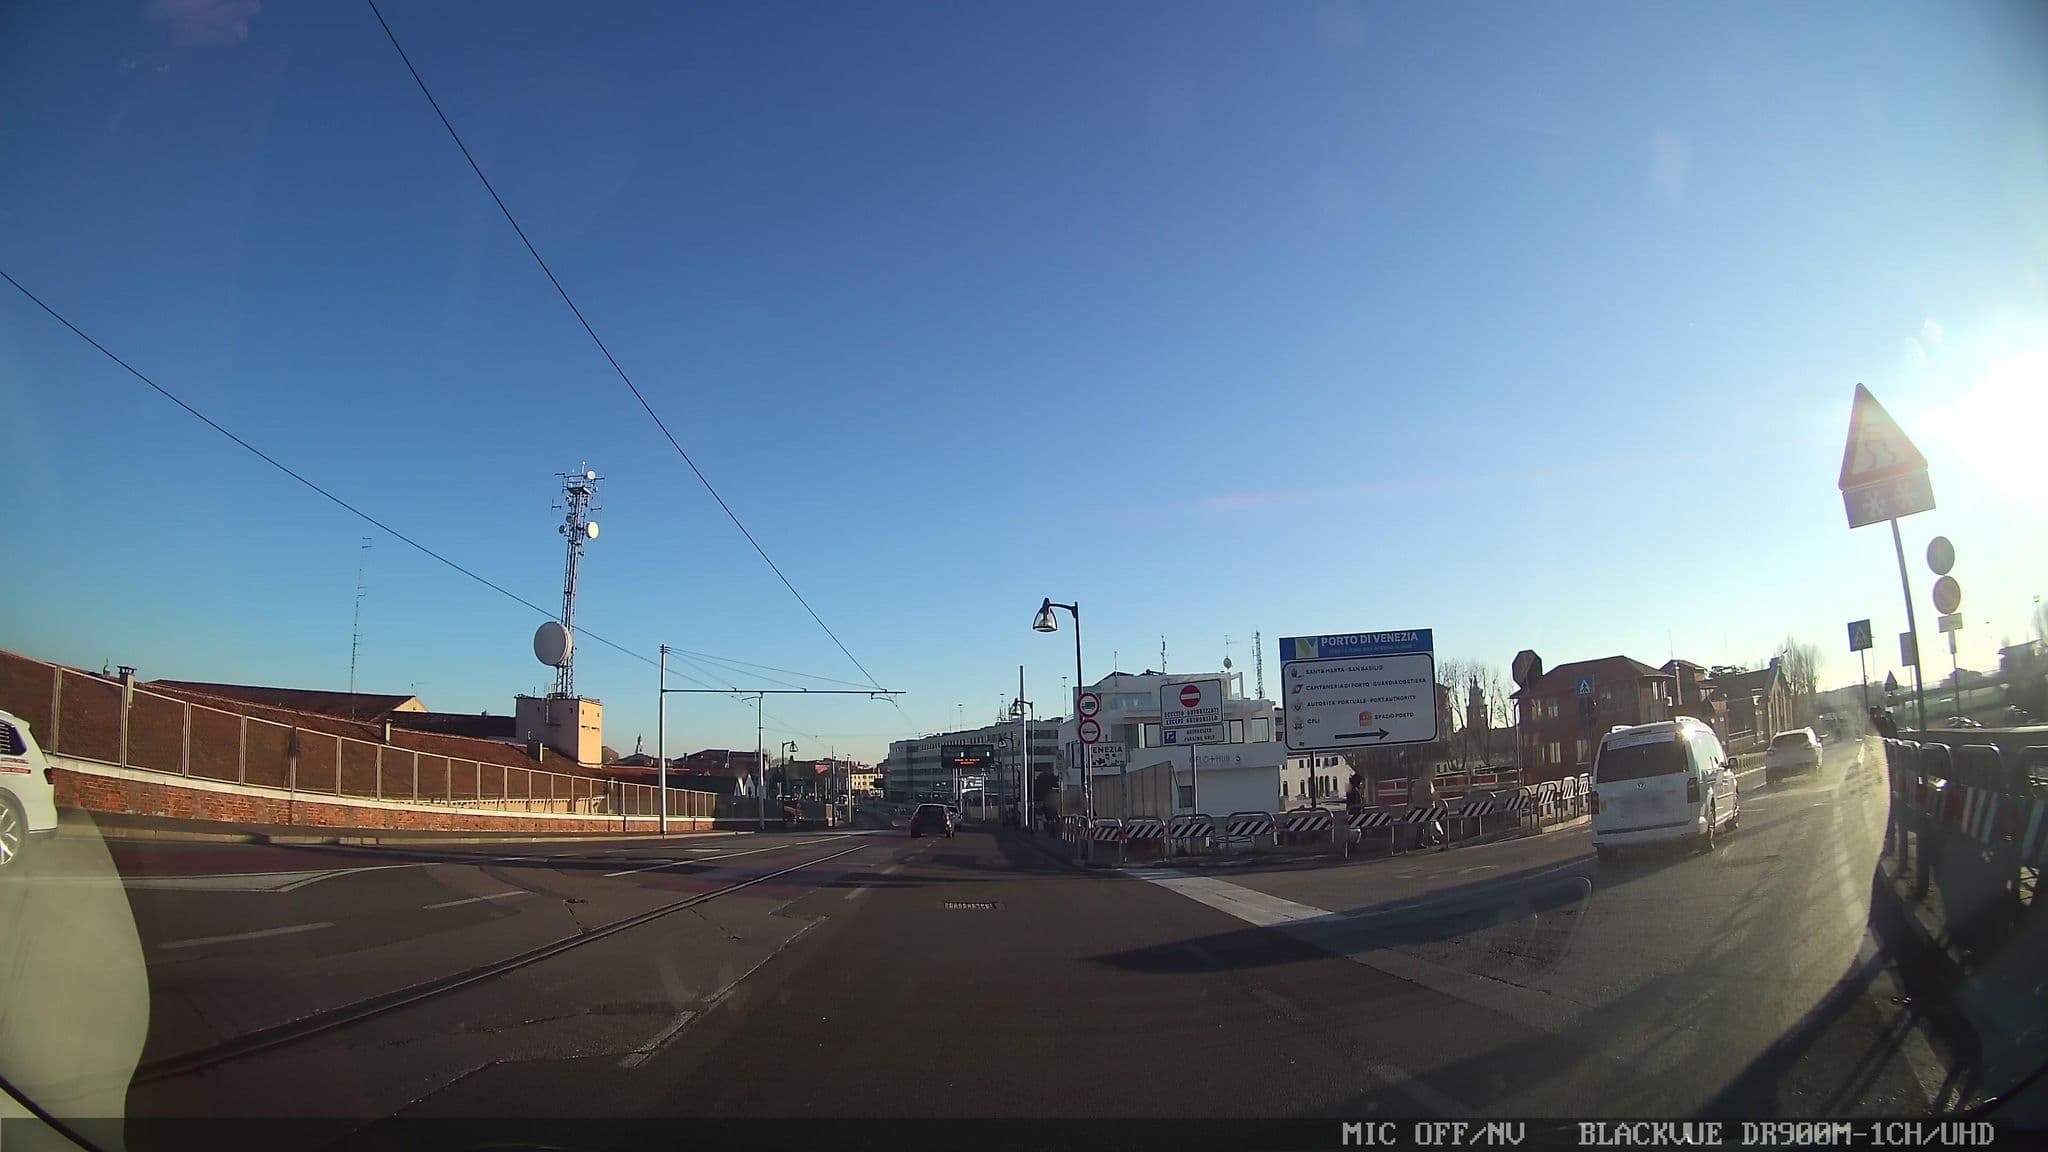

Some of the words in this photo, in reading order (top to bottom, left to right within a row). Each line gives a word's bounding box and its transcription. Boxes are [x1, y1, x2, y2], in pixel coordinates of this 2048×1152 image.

[1321, 636, 1358, 646] PORTO
[1360, 634, 1371, 644] DI
[1373, 632, 1418, 643] VENEZIA
